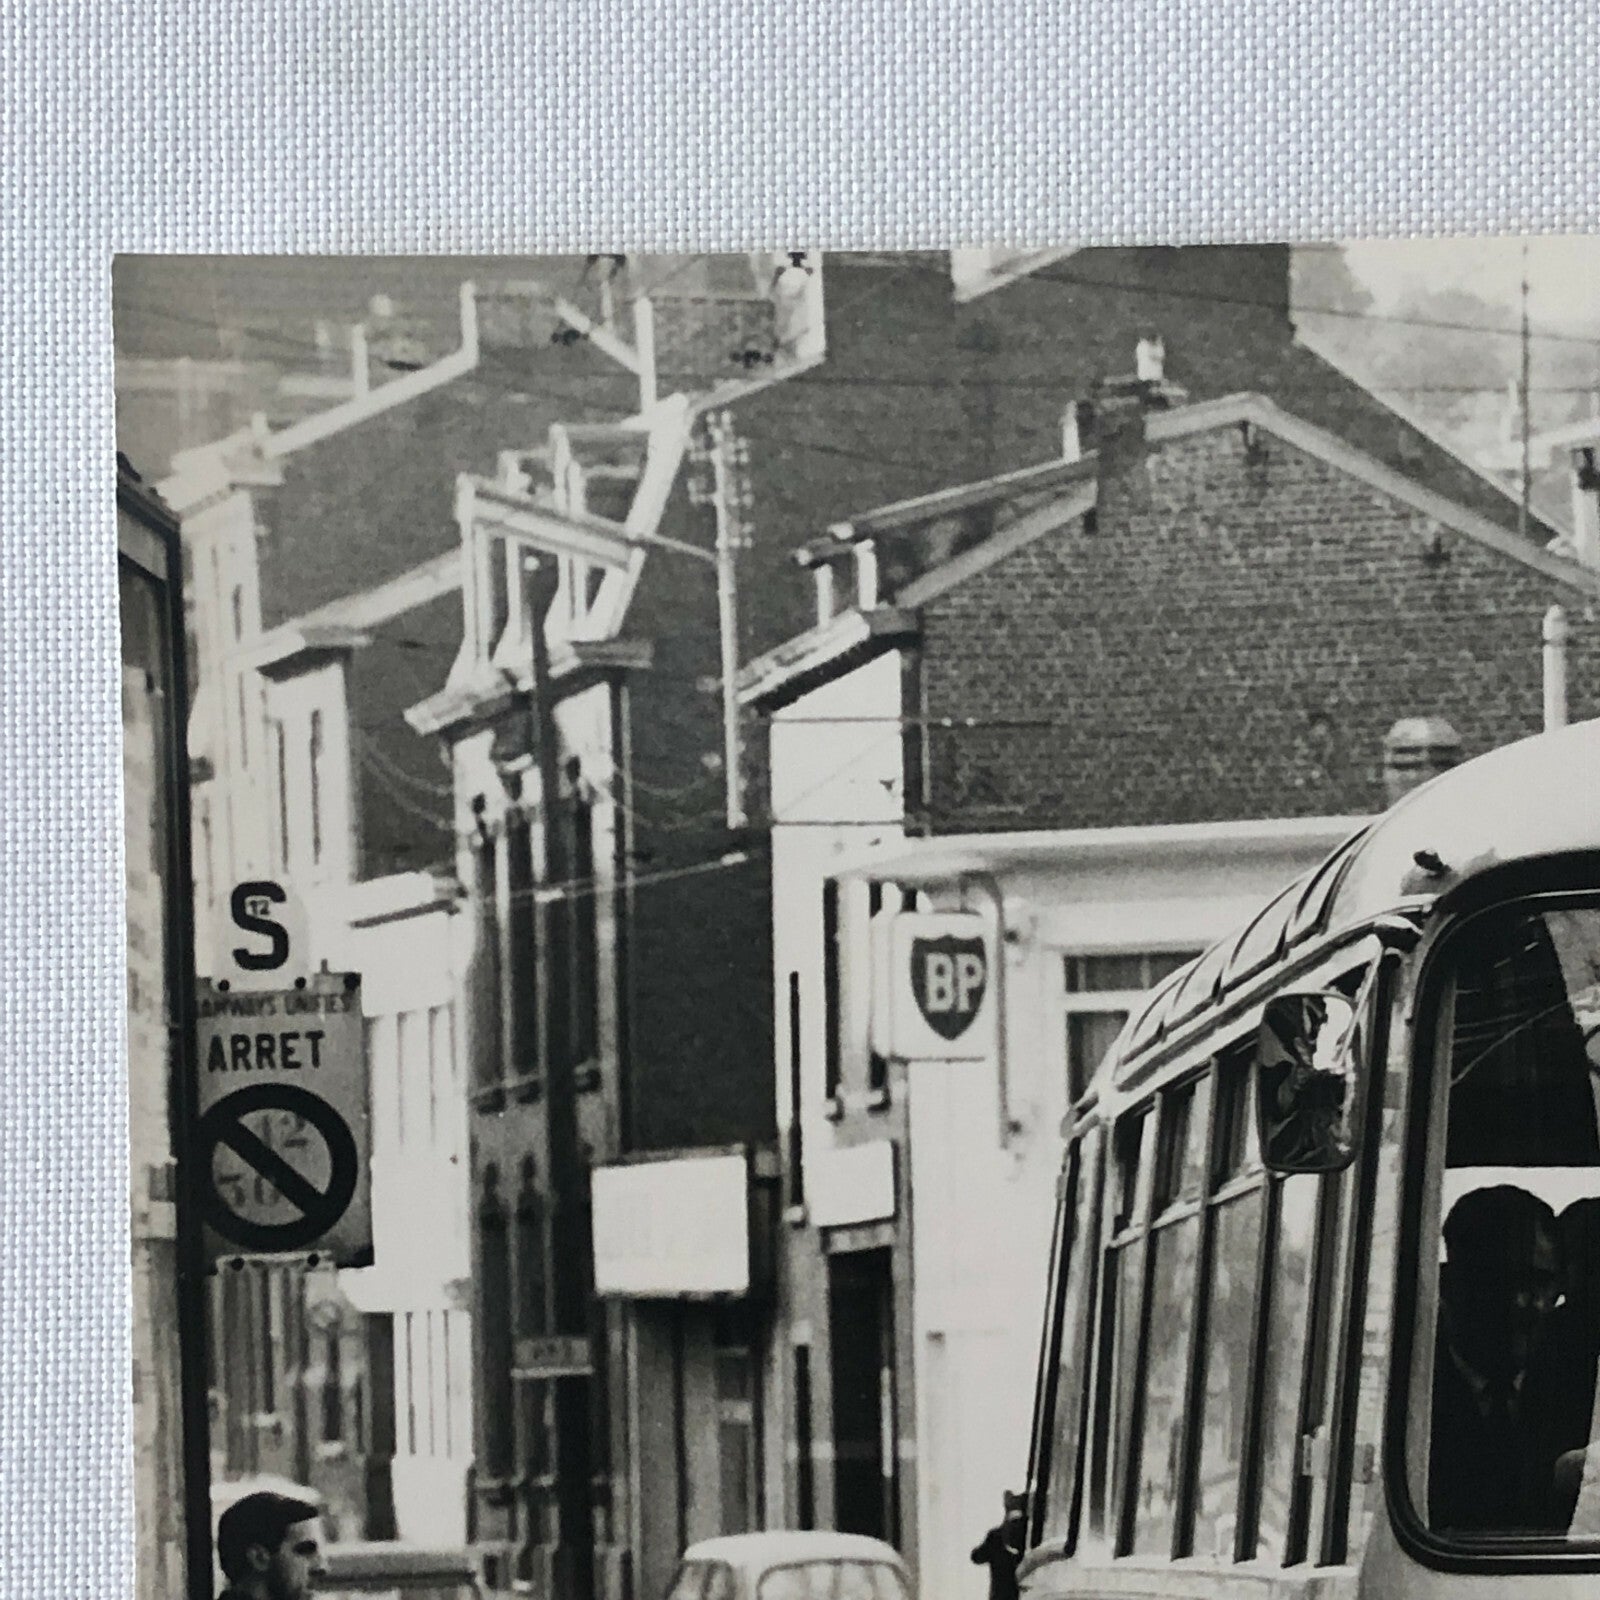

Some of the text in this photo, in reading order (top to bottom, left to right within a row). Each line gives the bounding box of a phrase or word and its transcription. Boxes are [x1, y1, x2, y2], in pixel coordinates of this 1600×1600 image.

[231, 881, 289, 970] S
[198, 996, 274, 1018] AMWAYS
[925, 953, 985, 1013] BP
[207, 1030, 325, 1073] ARRET
